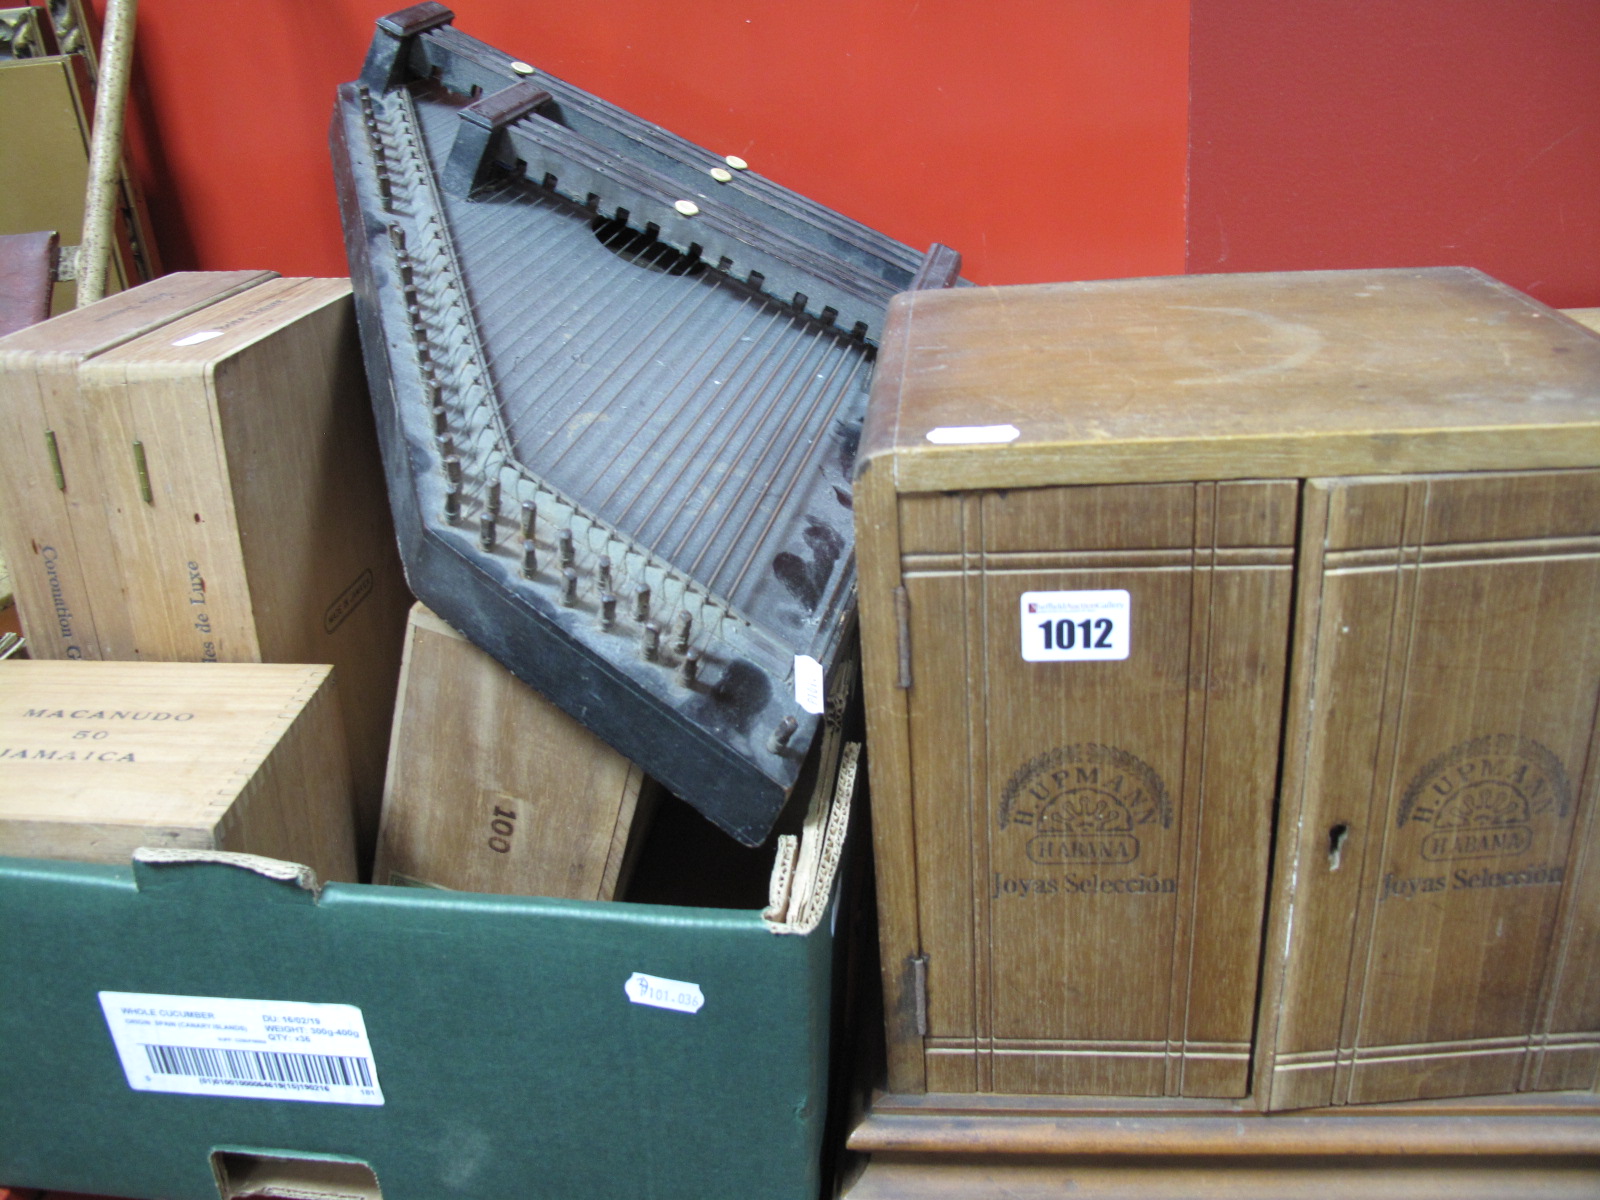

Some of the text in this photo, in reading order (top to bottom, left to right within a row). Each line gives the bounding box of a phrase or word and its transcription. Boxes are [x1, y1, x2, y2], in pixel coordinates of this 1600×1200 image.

[41, 545, 73, 638] Coronation
[187, 561, 206, 605] Luxe
[194, 613, 211, 633] de
[1038, 617, 1114, 650] 1012
[22, 708, 195, 722] MACANUDO
[71, 730, 110, 741] 50
[0, 748, 137, 763] JAMAICA
[487, 804, 518, 854] 100
[1037, 840, 1130, 859] HABANA
[992, 871, 1059, 899] Joyas
[1379, 871, 1447, 902] Joyas
[120, 1007, 216, 1019] WHOLE CUCUMBER
